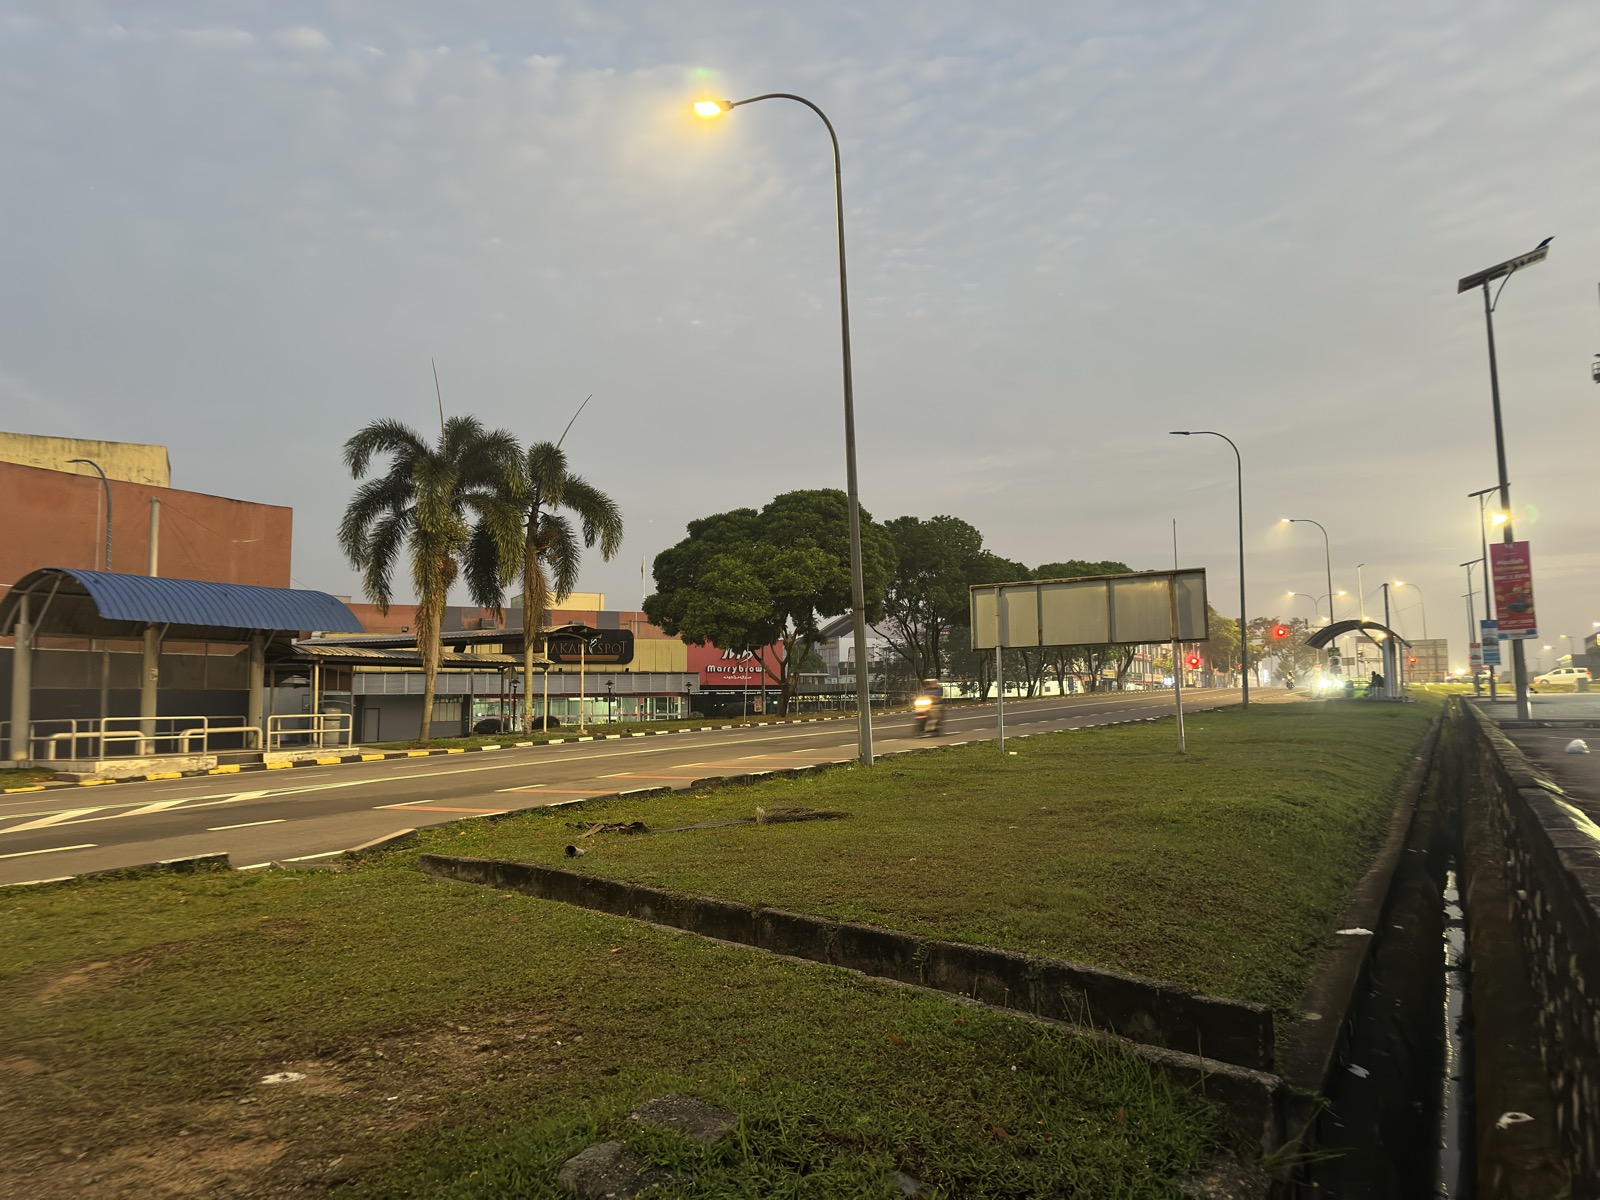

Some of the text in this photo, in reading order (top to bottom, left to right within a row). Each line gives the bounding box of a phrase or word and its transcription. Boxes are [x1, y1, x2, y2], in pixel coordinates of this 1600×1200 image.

[549, 641, 627, 654] AKAN SPOT
[707, 665, 766, 674] Marrybrow
